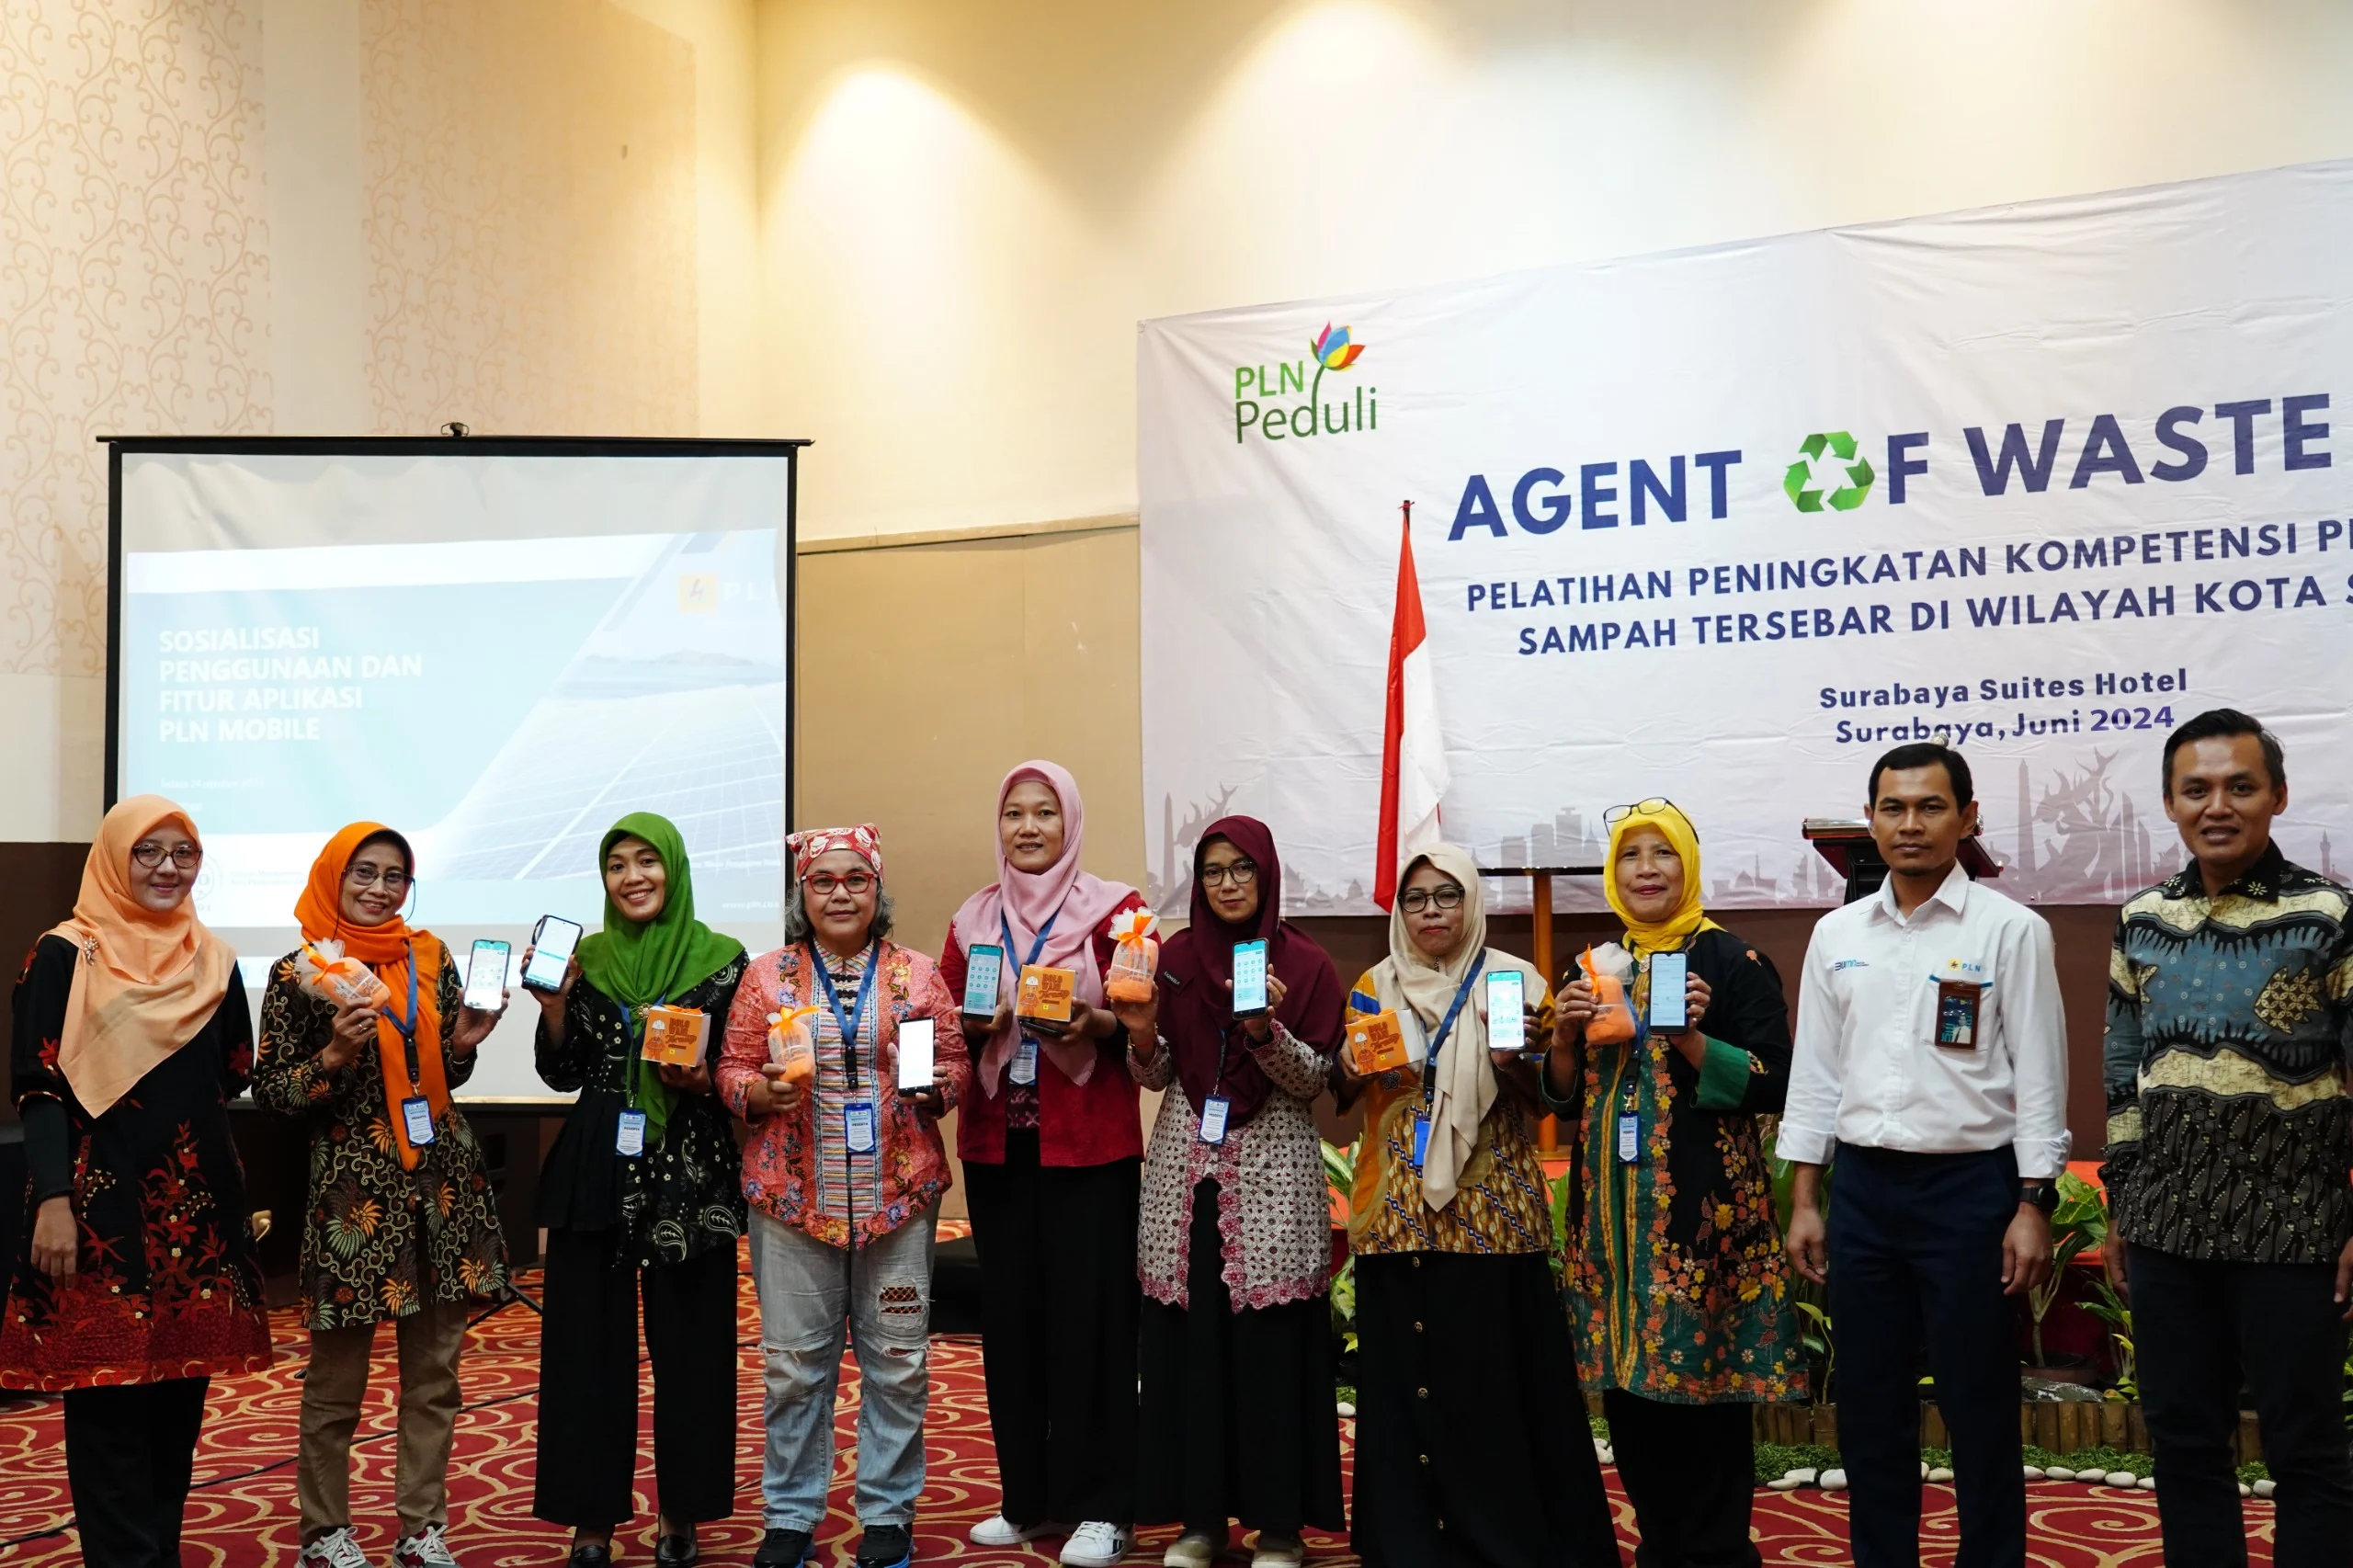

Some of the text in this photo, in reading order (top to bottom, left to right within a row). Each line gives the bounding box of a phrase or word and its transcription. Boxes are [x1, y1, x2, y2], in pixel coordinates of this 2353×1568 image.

[1235, 360, 1304, 400] PLN
[1235, 386, 1377, 445] Peduli
[1448, 449, 1743, 542] AGENT
[1963, 392, 2332, 497] WASTE
[1468, 570, 1672, 612] PELATIHAN
[1689, 546, 1987, 597] PENINGKATAN
[2006, 522, 2297, 574] KOMPETENSI
[1518, 618, 1677, 656] SAMPAH
[1692, 604, 1895, 645] TERSEBAR
[1911, 599, 1949, 632] DI
[1965, 585, 2175, 628] WILAYAH
[2195, 575, 2327, 614] KOTA
[158, 626, 320, 653] SOSIALISASI
[159, 653, 423, 683] PENGGUNAAN DAN
[160, 686, 363, 713] FITUR APLIKASI
[1820, 668, 2187, 710] Surabaya Suites Hotel
[160, 717, 320, 743] PLN MOBILE
[2090, 705, 2175, 732] 2024
[1961, 963, 1982, 972] PLN
